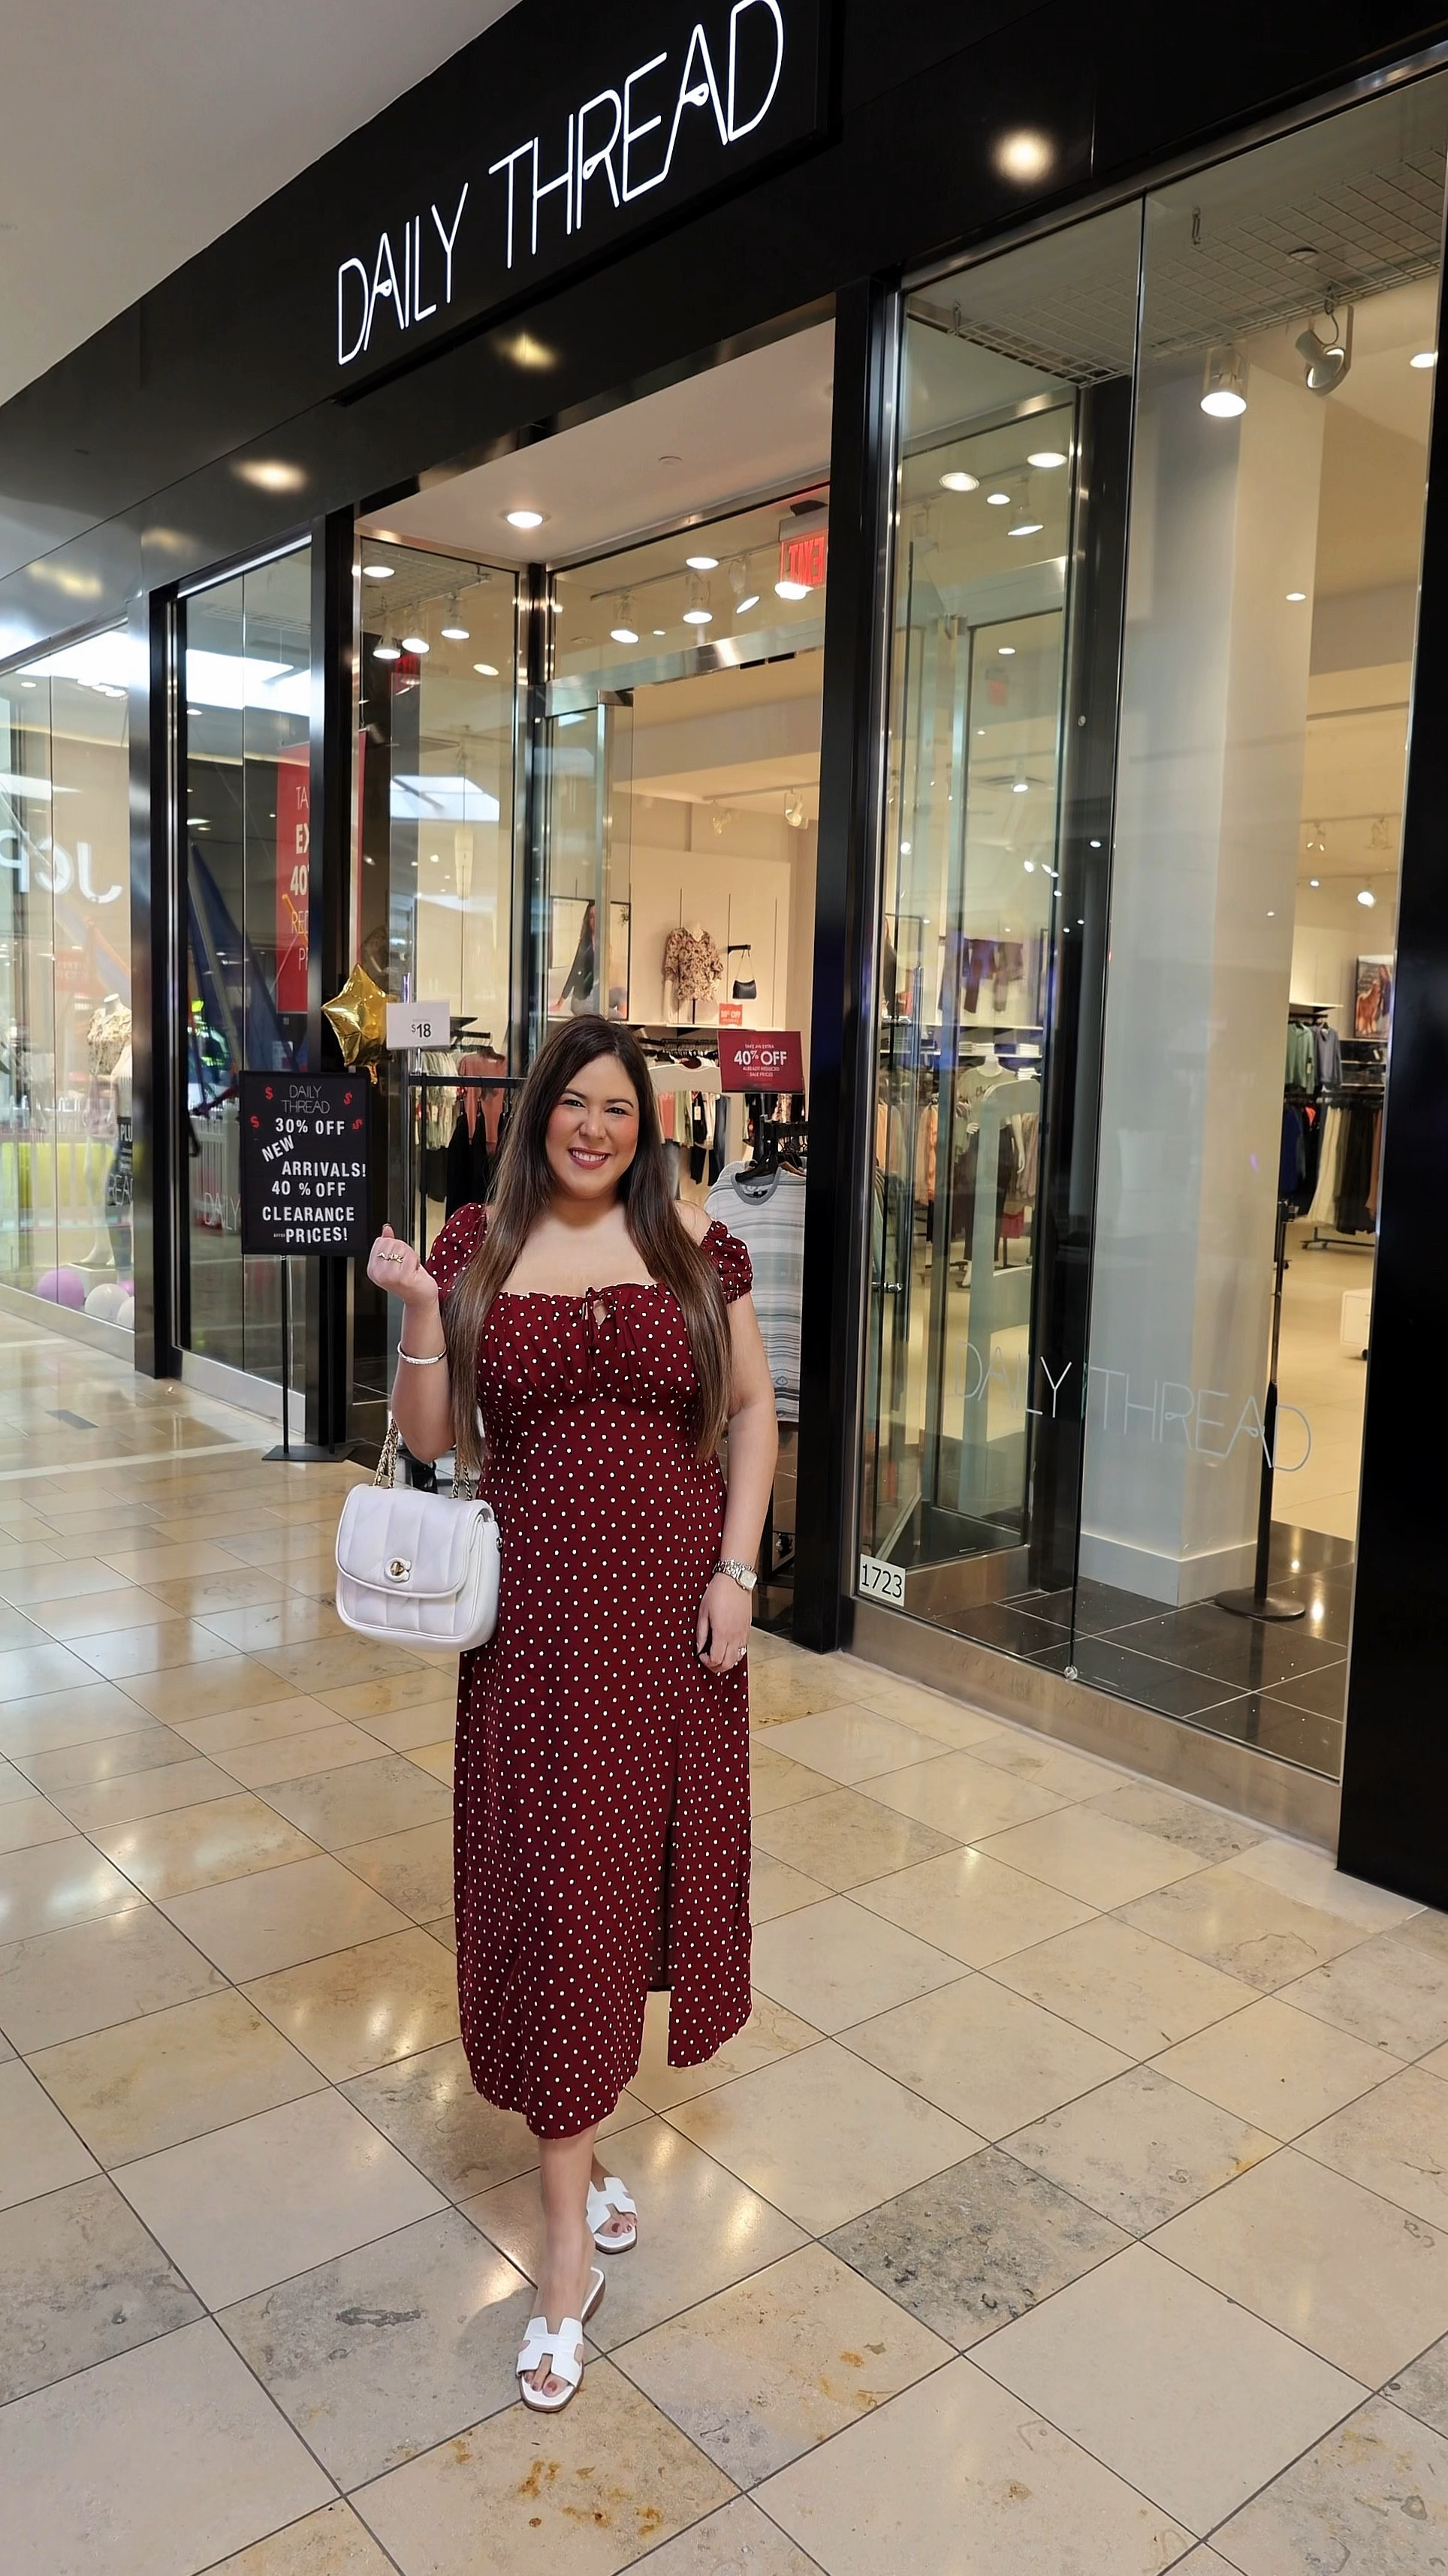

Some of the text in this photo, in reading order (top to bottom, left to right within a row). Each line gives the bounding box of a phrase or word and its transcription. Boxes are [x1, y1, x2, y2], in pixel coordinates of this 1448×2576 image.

[338, 0, 783, 365] DAILY THREAD
[290, 863, 309, 896] 40
[411, 1023, 432, 1038] $18
[733, 1050, 787, 1065] 40% OFF
[289, 1084, 322, 1098] DAILY
[280, 1099, 330, 1114] THREAD
[275, 1116, 345, 1136] 30% OFF
[261, 1134, 294, 1163] NEW
[281, 1160, 367, 1178] ARRIVALS!
[315, 1181, 346, 1198] OFF
[204, 1192, 241, 1232] DAILY
[261, 1205, 355, 1222] CLEARANCE
[285, 1226, 348, 1244] PRICES!
[954, 1341, 1311, 1472] DAILY THREAD
[861, 1563, 902, 1598] 1723
